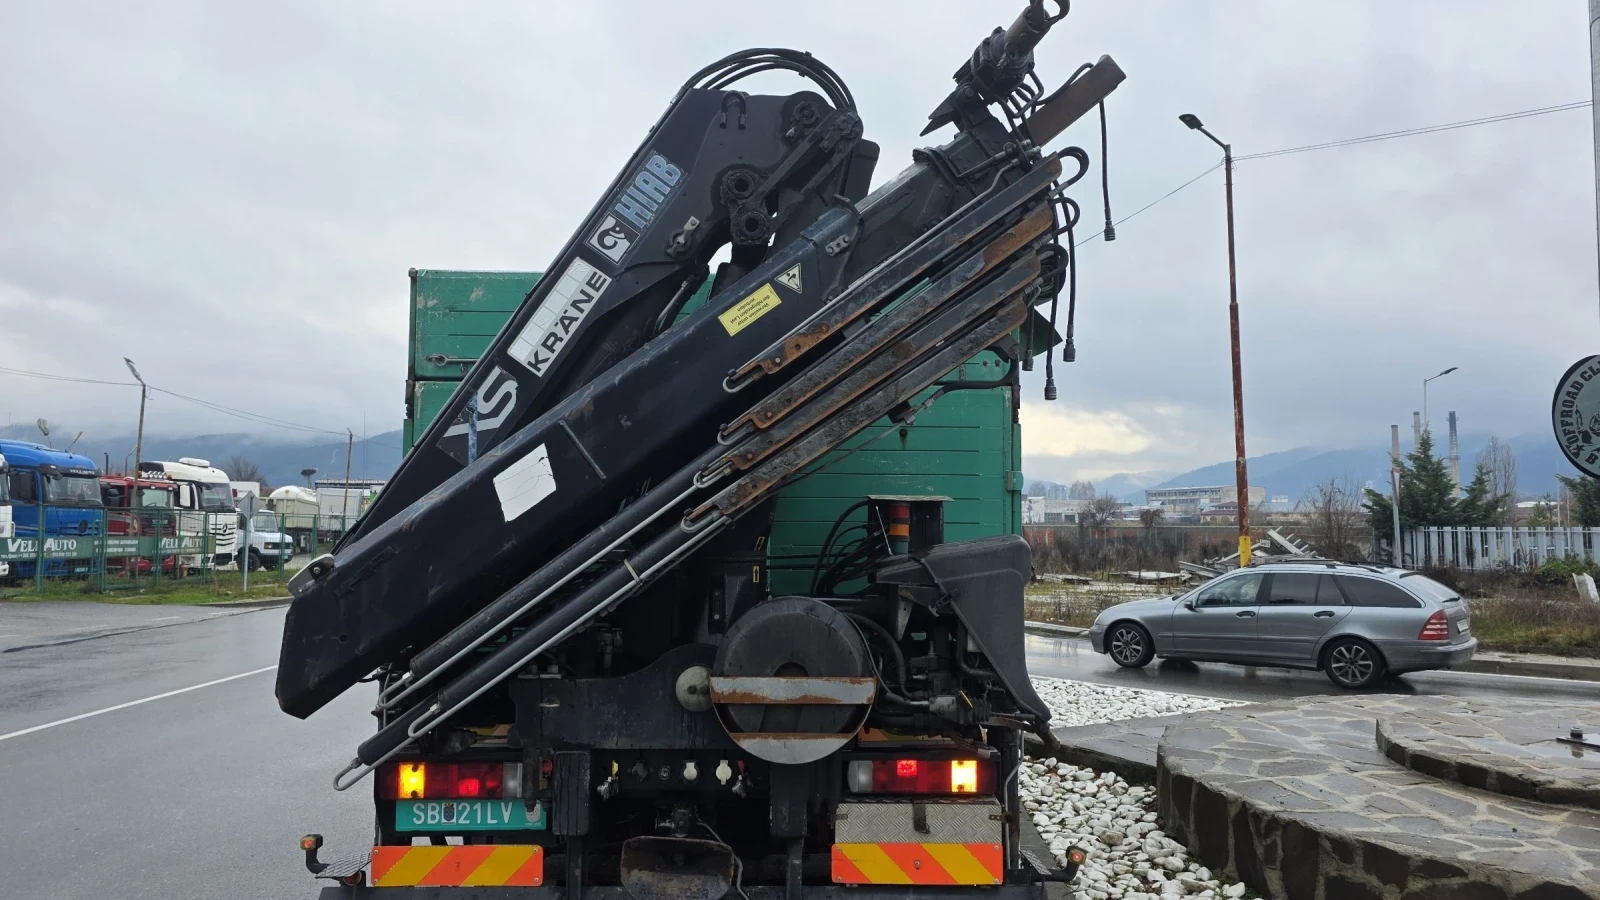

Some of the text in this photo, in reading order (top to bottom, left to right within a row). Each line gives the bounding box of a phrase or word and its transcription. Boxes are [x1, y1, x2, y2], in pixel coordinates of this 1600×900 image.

[615, 155, 681, 229] HIAB
[527, 271, 611, 374] KRÄNE
[1560, 380, 1585, 445] OFFROAD
[7, 538, 77, 553] VELI AUTO
[412, 802, 440, 825] SB
